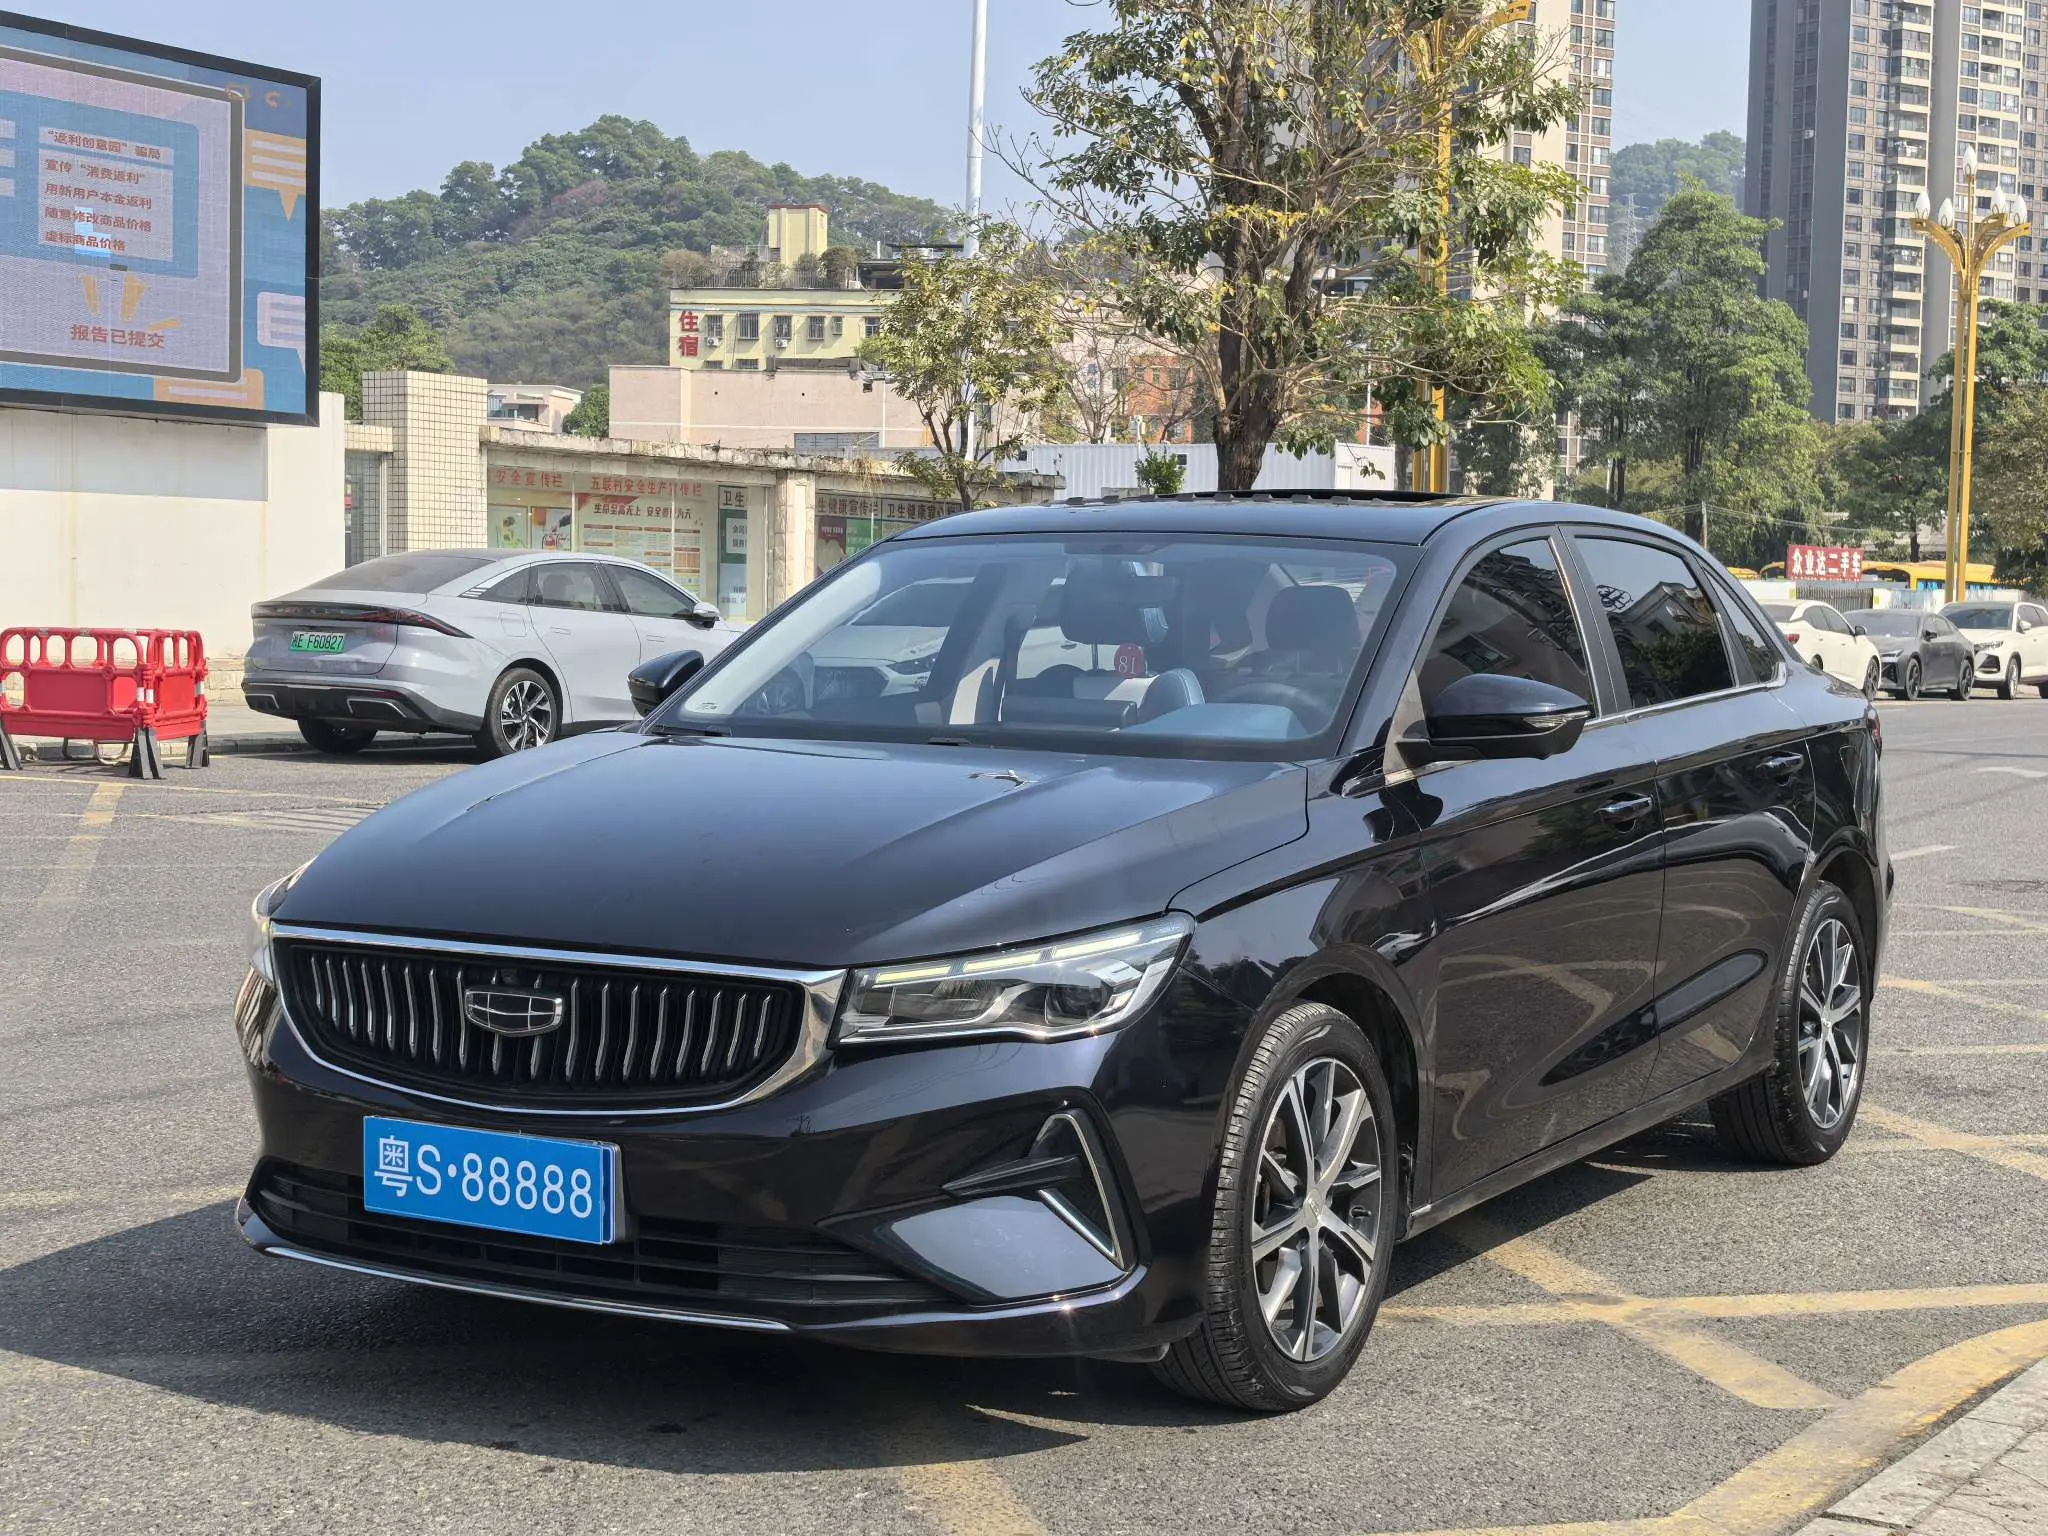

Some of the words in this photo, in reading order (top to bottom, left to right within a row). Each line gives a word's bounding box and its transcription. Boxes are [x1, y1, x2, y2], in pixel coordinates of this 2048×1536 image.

[45, 159, 72, 173] 宣传
[45, 183, 152, 210] 用新用户本金返利
[45, 207, 152, 232] 随意修改商品价格
[45, 230, 126, 251] 虚标商品价格
[70, 324, 165, 349] 报告已提交
[679, 310, 699, 356] 住宿
[496, 469, 563, 488] 安全宣传栏
[723, 490, 745, 508] 卫生
[1118, 655, 1137, 674] 81
[374, 1135, 593, 1219] 粤S·88888
